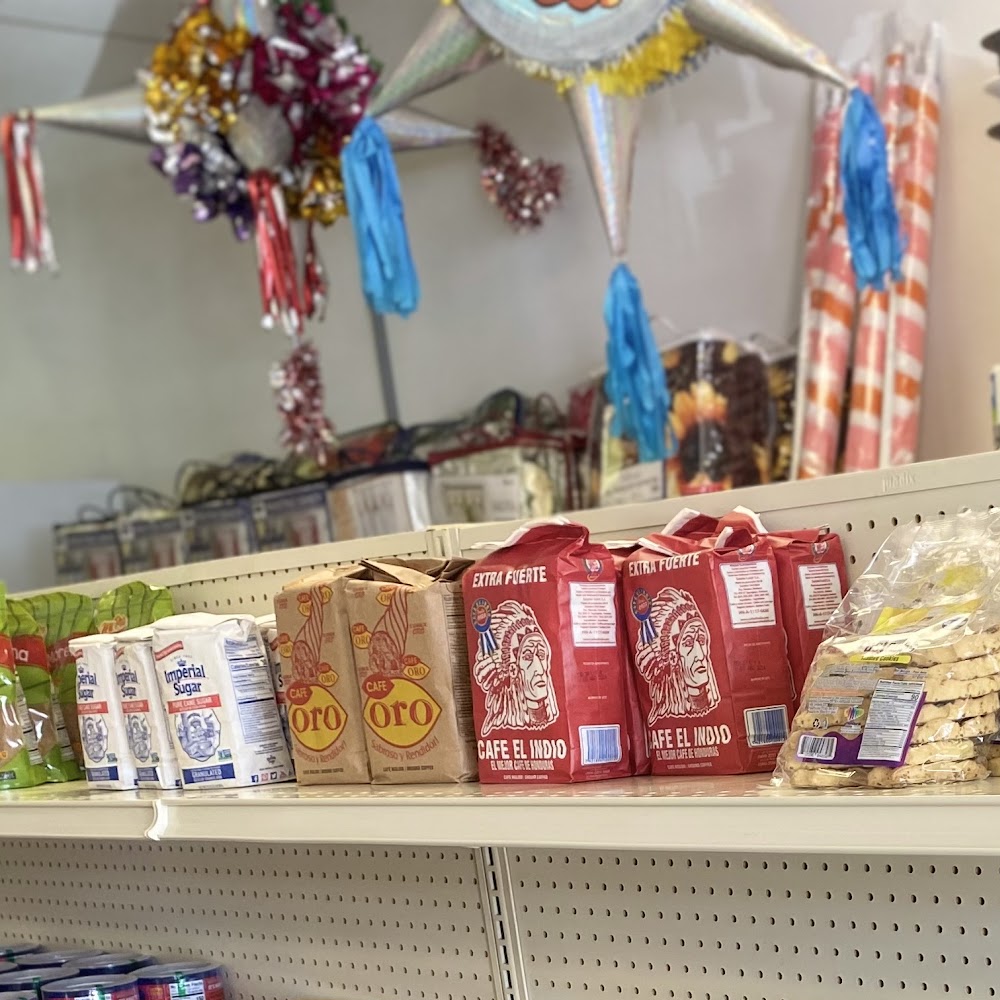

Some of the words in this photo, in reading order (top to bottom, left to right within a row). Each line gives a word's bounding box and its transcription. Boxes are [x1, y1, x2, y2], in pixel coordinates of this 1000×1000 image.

[628, 559, 656, 577] EXTRA
[659, 553, 700, 573] FUERTE
[473, 572, 503, 588] EXTRA
[505, 566, 547, 585] FUERTE
[164, 664, 206, 684] Imperial
[408, 665, 426, 677] ORO
[174, 681, 202, 697] Sugar
[289, 688, 308, 699] CAFE
[366, 680, 388, 693] CAFE
[676, 728, 691, 748] EL
[694, 724, 732, 747] INDIO
[477, 740, 509, 760] CAFE
[512, 739, 527, 760] EL
[530, 738, 567, 760] INDIO
